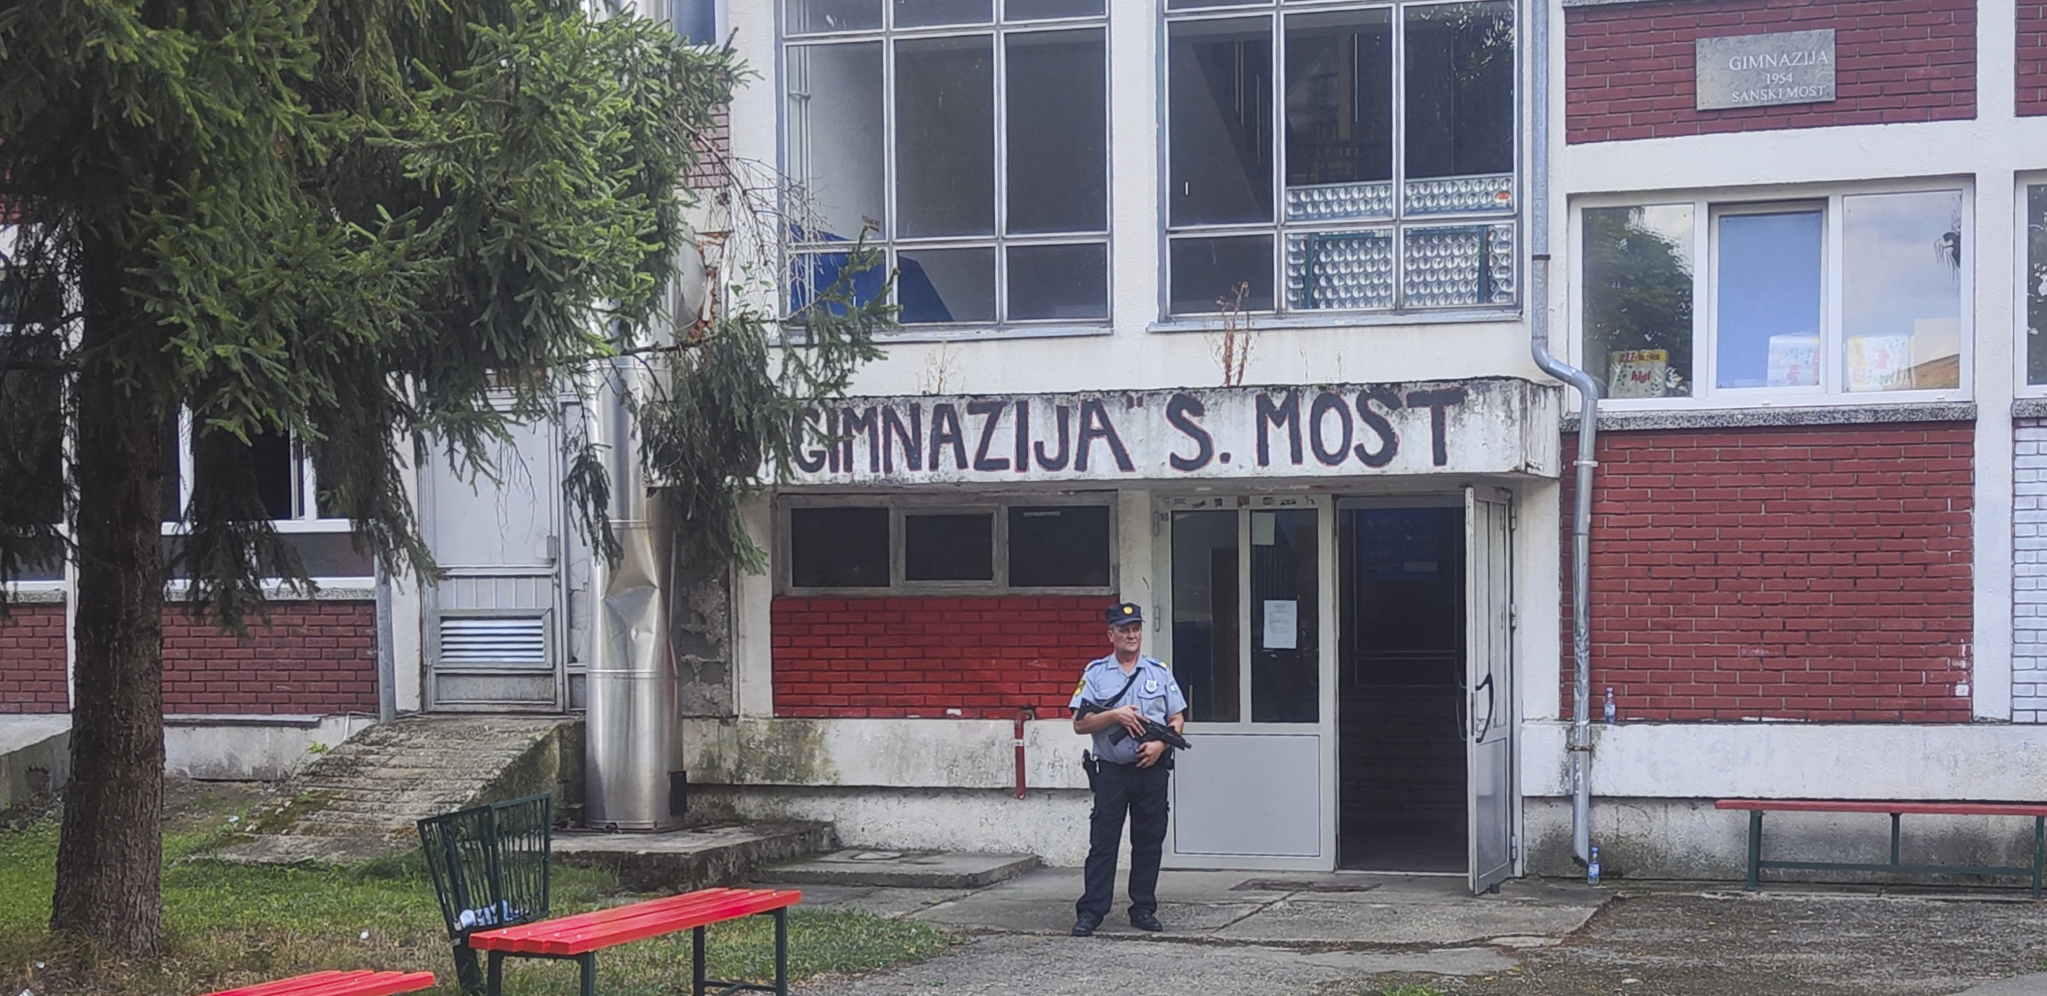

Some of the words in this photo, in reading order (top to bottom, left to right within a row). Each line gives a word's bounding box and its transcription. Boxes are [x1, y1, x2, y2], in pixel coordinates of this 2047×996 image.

[1728, 51, 1829, 71] GIMNAZIJA
[1765, 73, 1794, 85] 1954
[1731, 88, 1783, 103] SANSKI
[1785, 85, 1827, 99] MOST
[1165, 392, 1232, 473] S.
[1255, 385, 1468, 469] MOST
